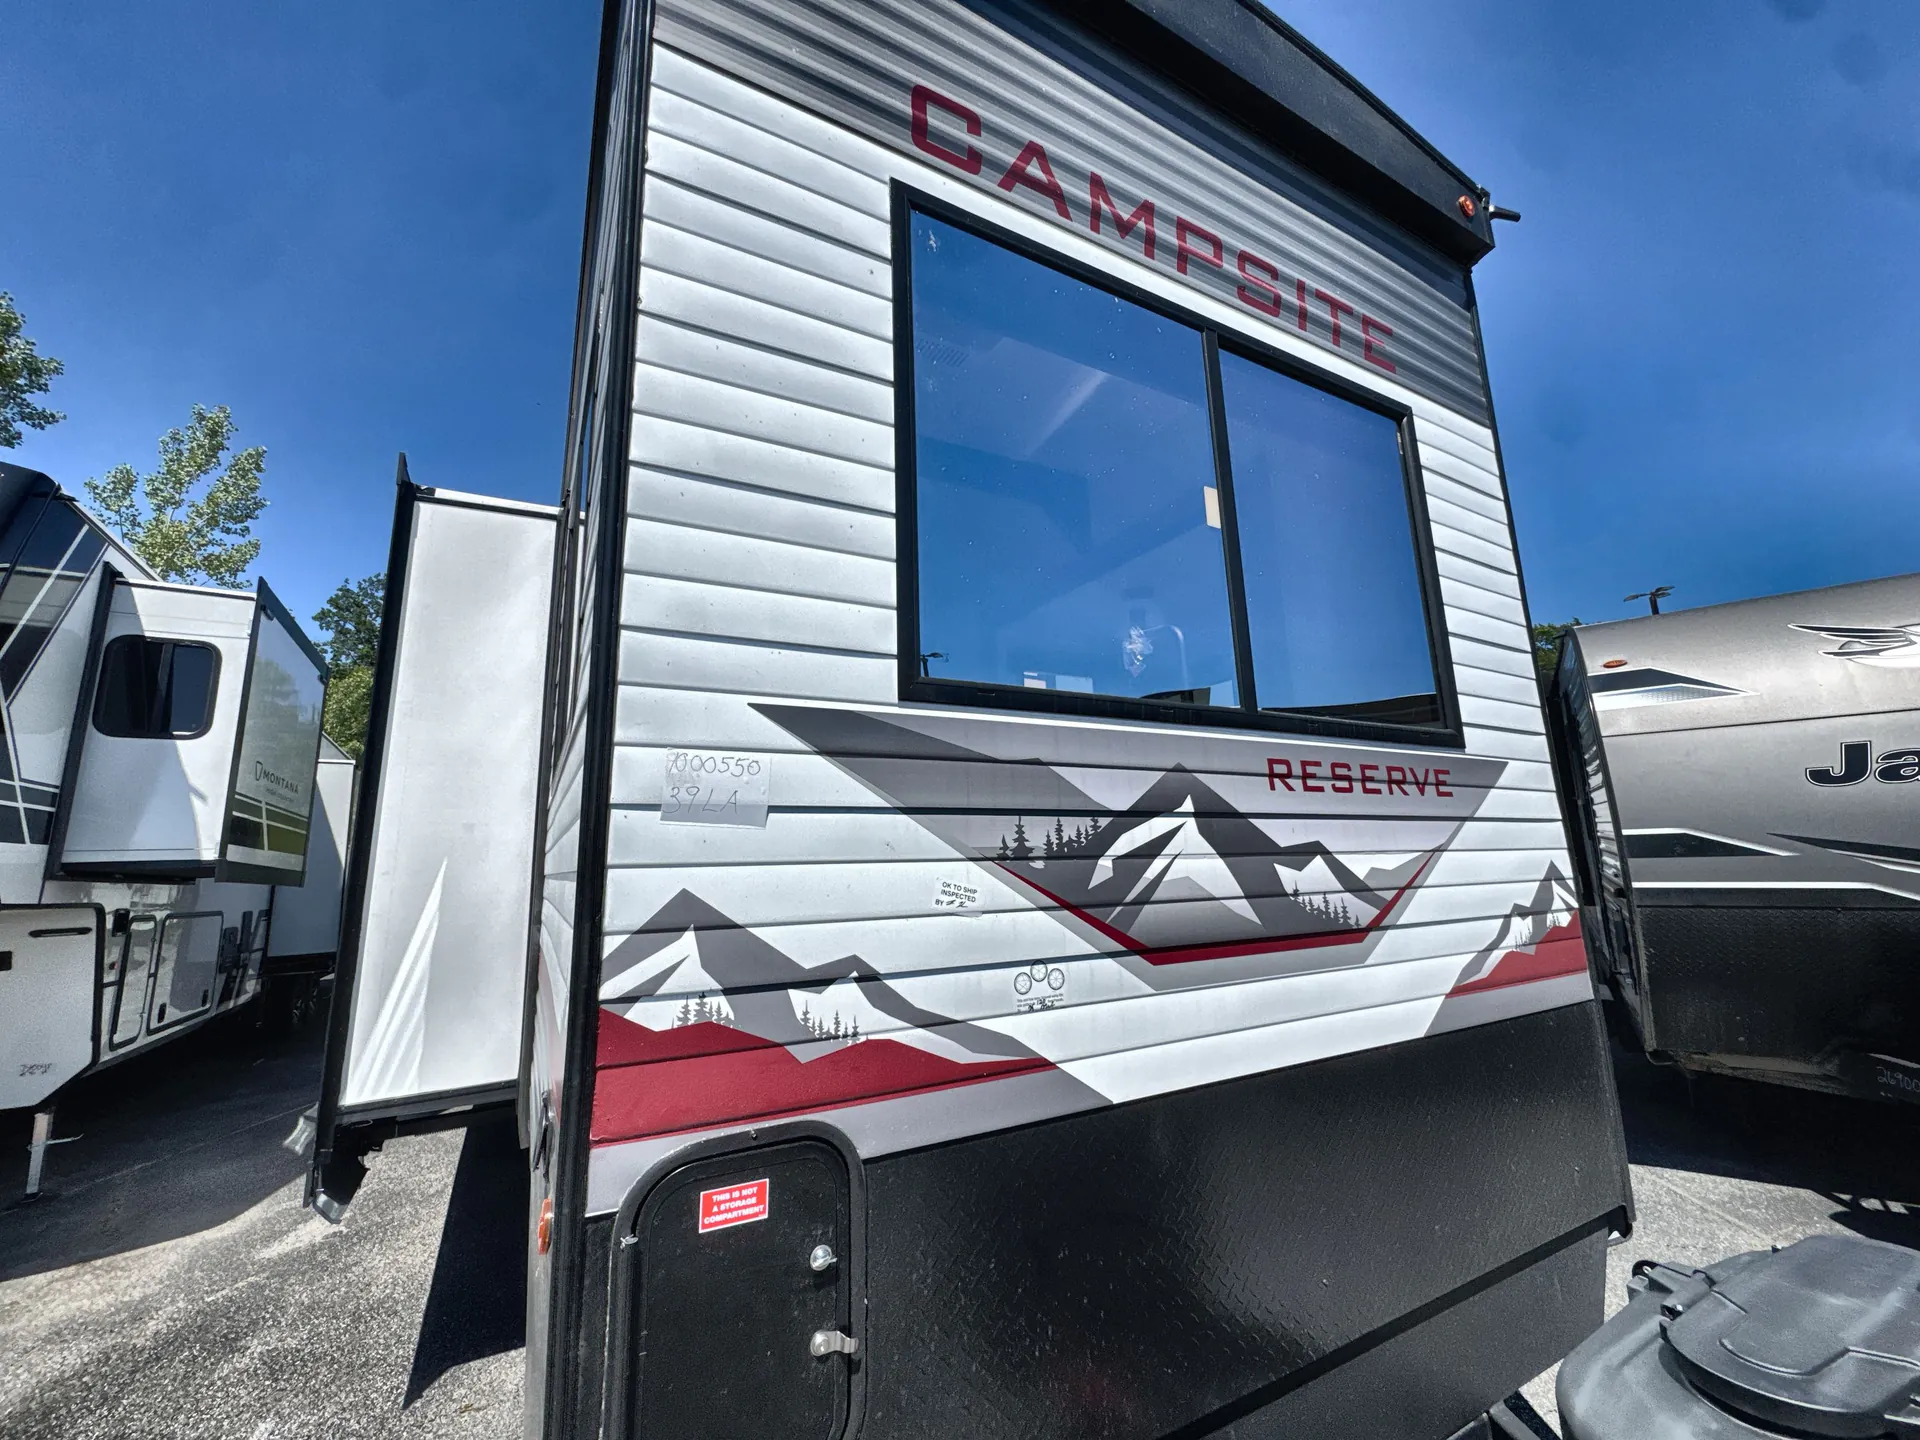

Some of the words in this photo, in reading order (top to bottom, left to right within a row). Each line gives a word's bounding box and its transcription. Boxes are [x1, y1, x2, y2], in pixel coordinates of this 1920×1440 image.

[910, 84, 1397, 375] CAMPSITE
[1804, 740, 1920, 787] Ja
[263, 769, 299, 795] MONTANA
[1266, 758, 1454, 797] RESERVE
[940, 889, 977, 903] INSPECTED
[942, 881, 952, 890] OK
[953, 884, 962, 892] TO
[963, 886, 978, 895] SHIP
[934, 898, 945, 906] BY
[712, 1192, 730, 1203] THIS
[732, 1190, 740, 1199] IS
[741, 1186, 758, 1197] NOT
[712, 1205, 719, 1213] A
[720, 1196, 757, 1211] STORAGE
[703, 1204, 765, 1225] COMPARTMENT
